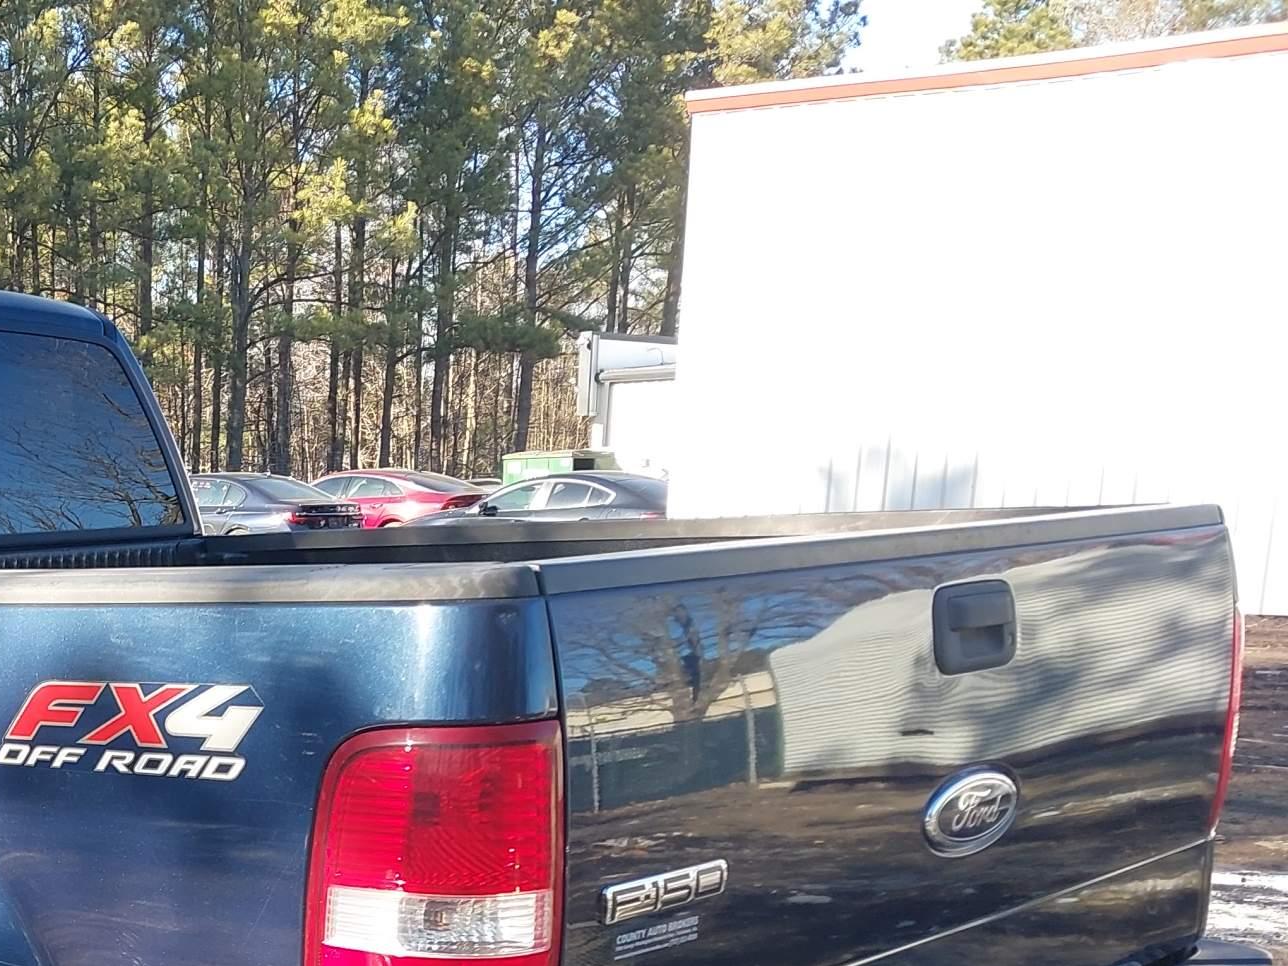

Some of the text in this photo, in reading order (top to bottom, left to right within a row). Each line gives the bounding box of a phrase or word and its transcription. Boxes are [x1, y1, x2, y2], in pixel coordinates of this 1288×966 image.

[4, 681, 264, 753] FX4
[94, 749, 247, 781] ROAD
[616, 928, 647, 945] COUNTY
[647, 923, 667, 938] AUTO
